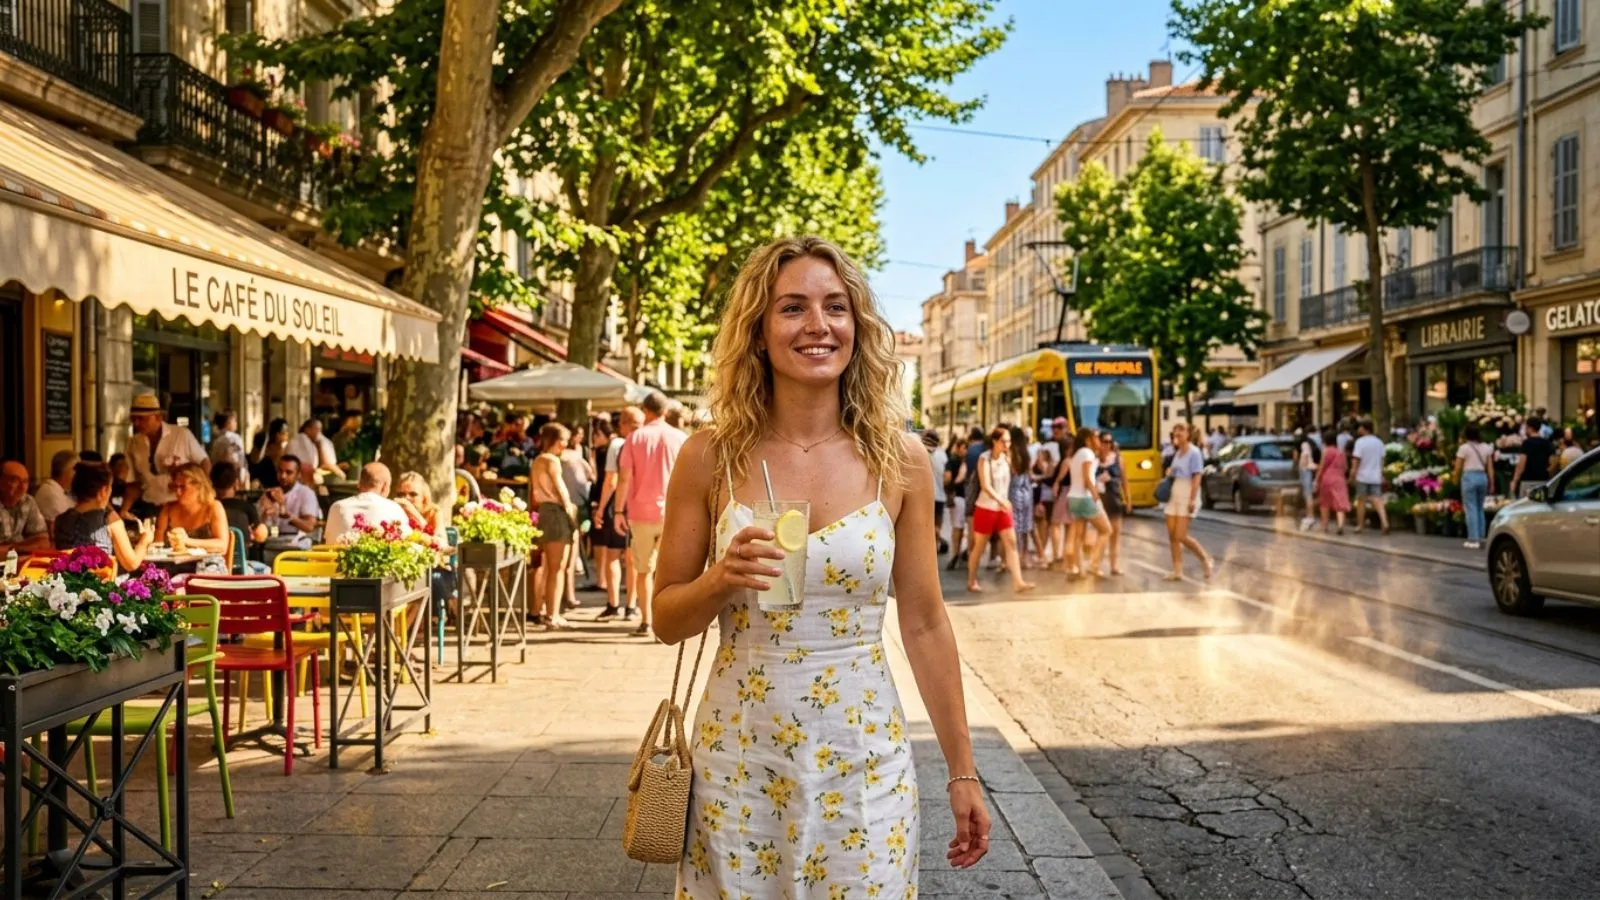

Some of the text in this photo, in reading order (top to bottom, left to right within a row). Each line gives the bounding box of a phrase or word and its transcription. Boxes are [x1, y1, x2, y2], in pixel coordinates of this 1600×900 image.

[173, 267, 343, 337] LE CAFÉ DU SOLEIL
[1421, 316, 1485, 348] LIBRAIRIE
